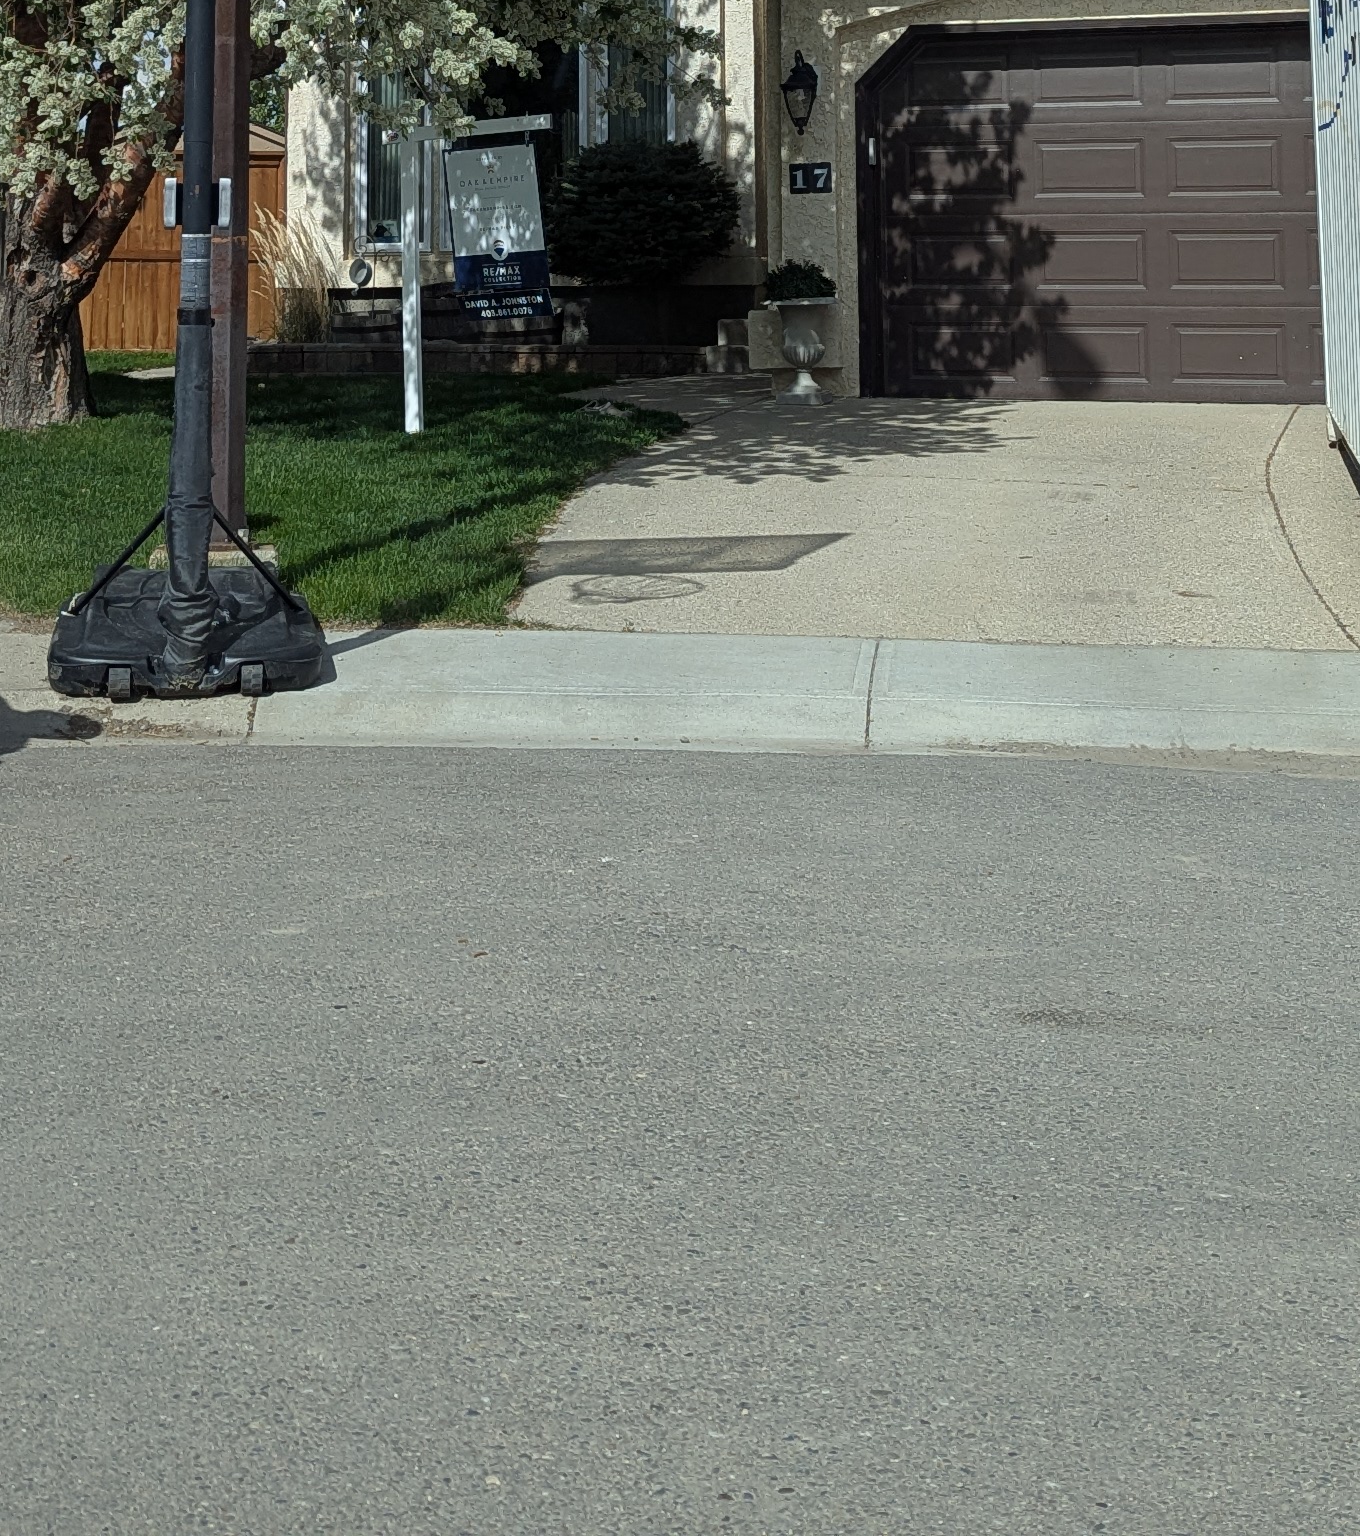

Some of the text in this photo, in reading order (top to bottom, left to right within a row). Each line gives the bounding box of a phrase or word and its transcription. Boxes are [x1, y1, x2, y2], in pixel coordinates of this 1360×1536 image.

[792, 167, 828, 189] 17
[482, 265, 521, 277] RE/MAX
[464, 299, 489, 309] DAVID
[501, 295, 544, 306] JOHNSTON
